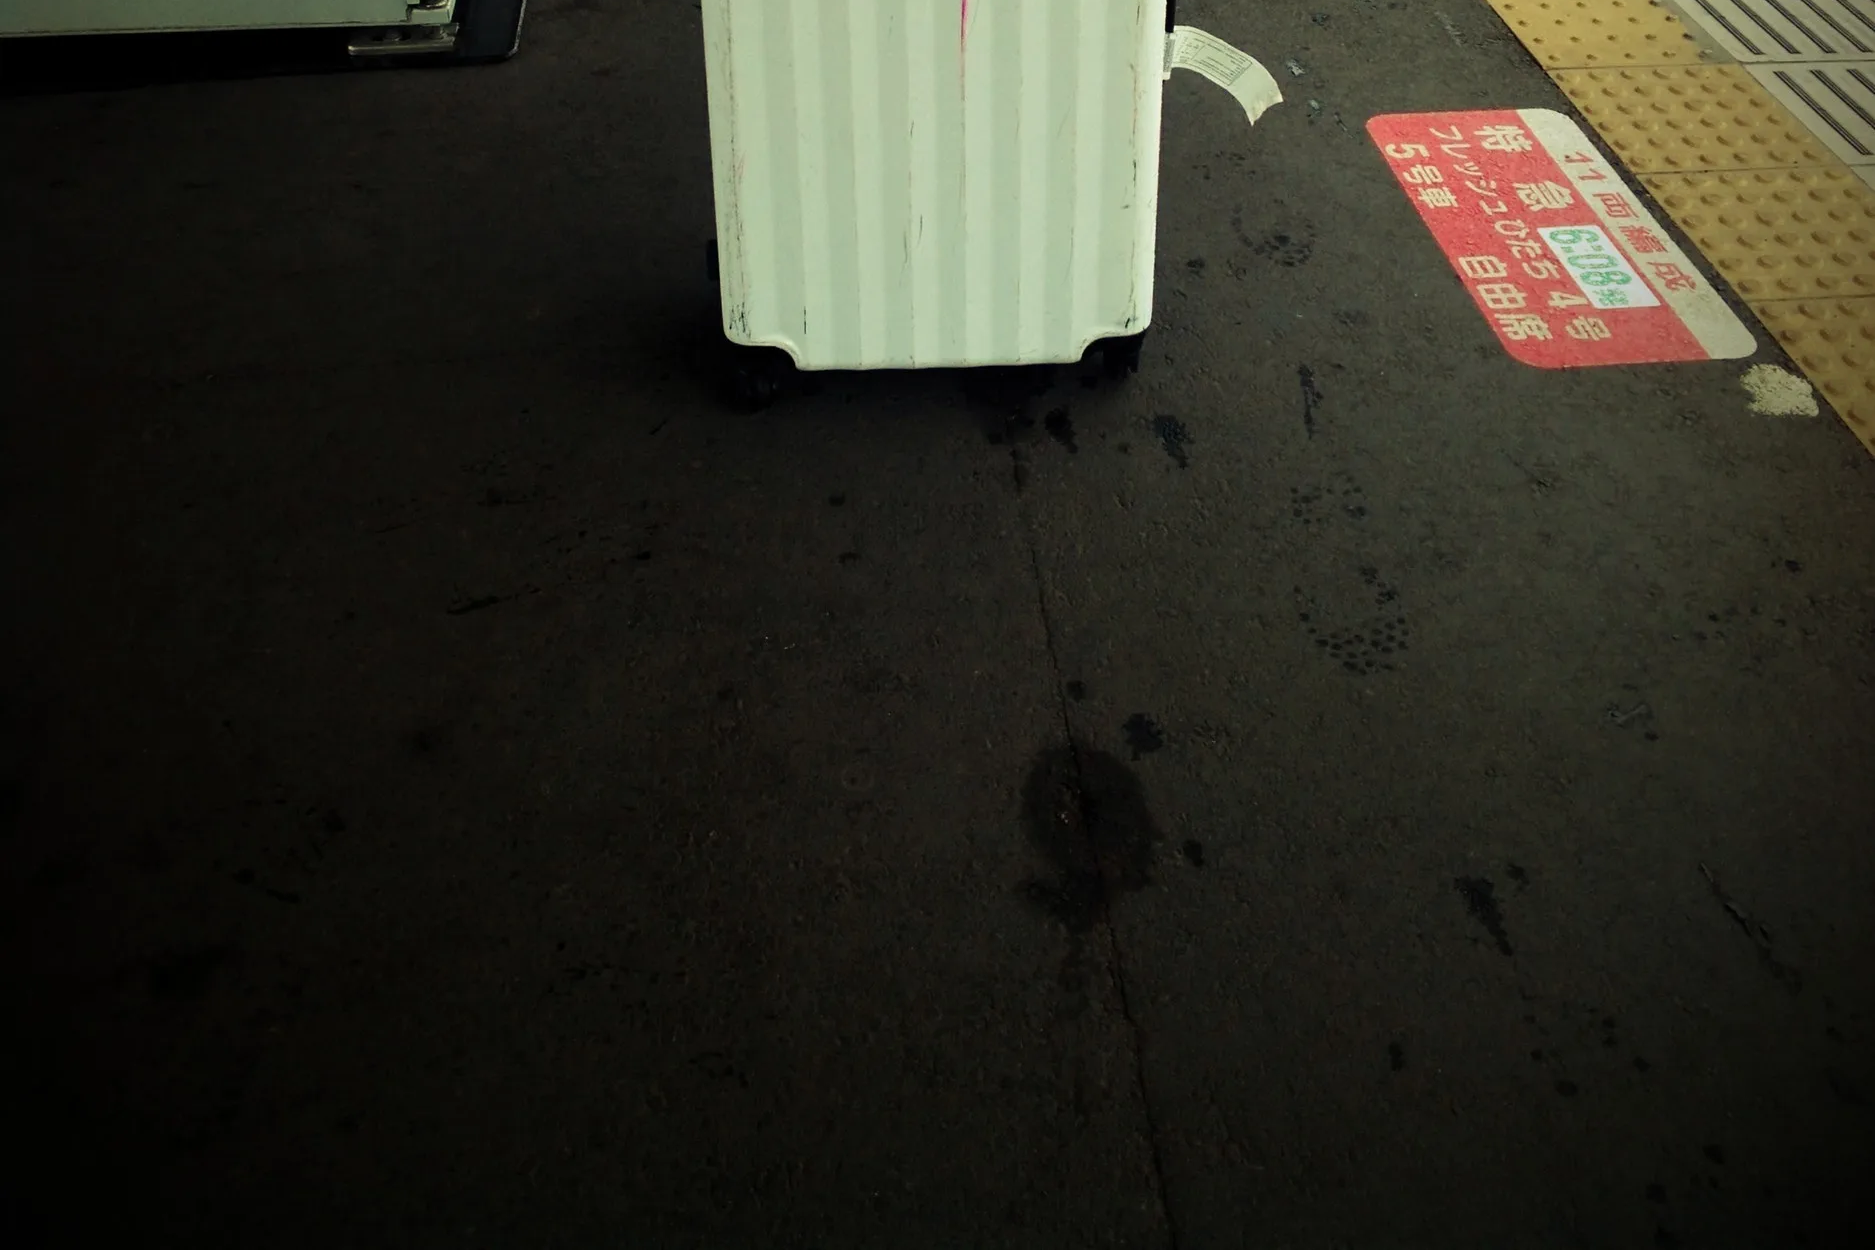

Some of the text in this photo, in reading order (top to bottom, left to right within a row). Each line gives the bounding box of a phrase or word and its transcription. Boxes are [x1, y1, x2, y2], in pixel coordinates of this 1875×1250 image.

[1384, 143, 1554, 341] 5号車 自由席
[1428, 124, 1561, 280] フレッシュひたち
[1473, 124, 1575, 212] 特急
[1564, 150, 1697, 293] 11両編成
